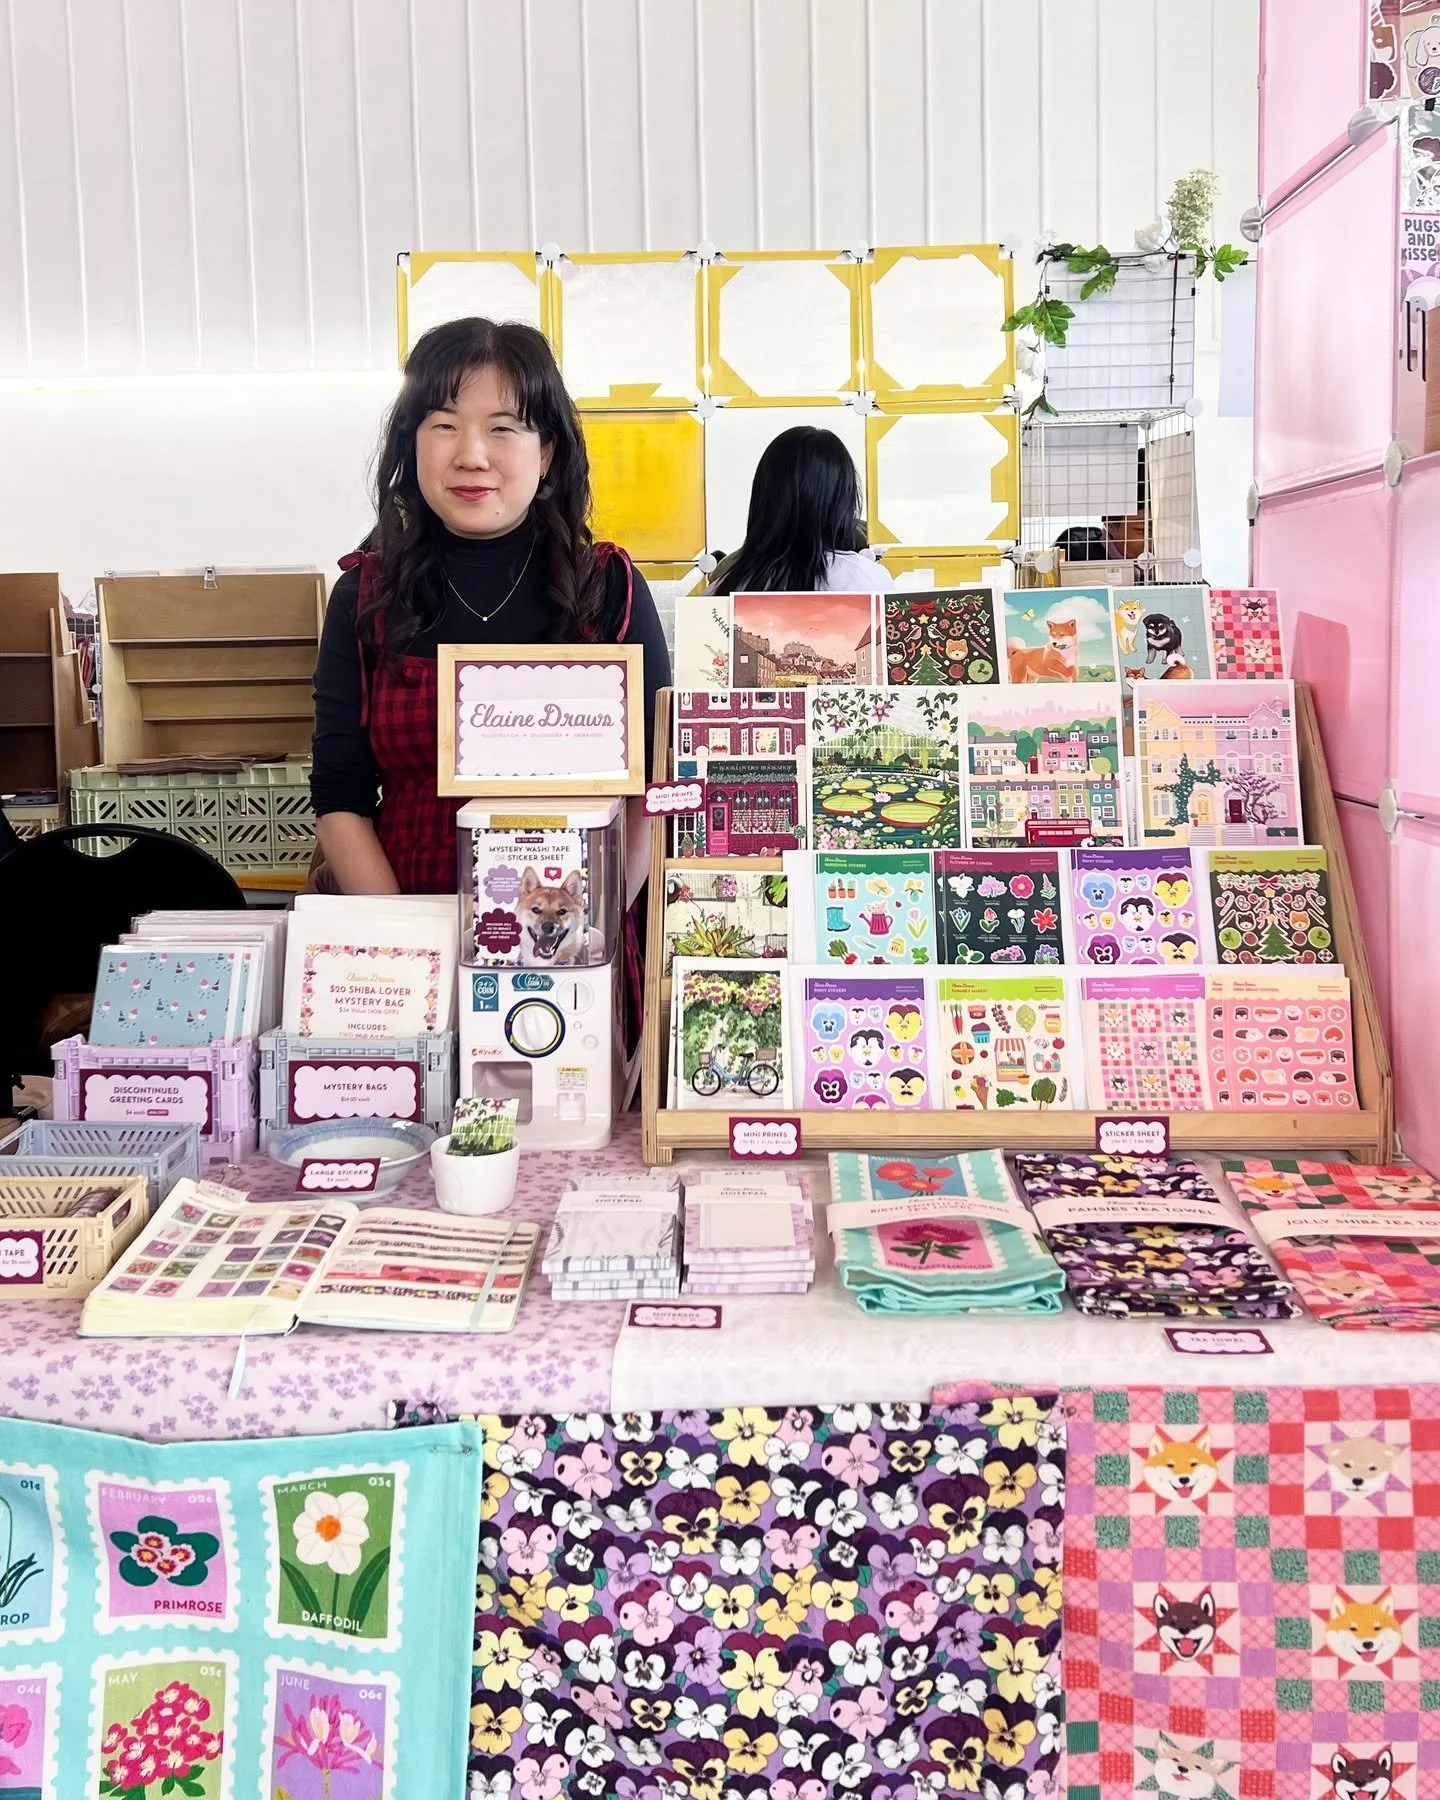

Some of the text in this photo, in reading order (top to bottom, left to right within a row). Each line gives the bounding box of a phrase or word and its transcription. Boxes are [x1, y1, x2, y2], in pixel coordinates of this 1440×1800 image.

[470, 703, 614, 728] Elaine Draws
[330, 985, 346, 993] $20
[478, 986, 494, 994] COIN
[335, 997, 404, 1007] MYSTERY BAG
[1164, 1207, 1216, 1215] TOWEL
[20, 1479, 41, 1491] 01¢
[278, 1481, 328, 1494] MARCH
[368, 1477, 392, 1488] 03¢
[101, 1487, 166, 1504] FEBRUARY
[154, 1600, 223, 1613] PRIMROSE
[302, 1610, 363, 1632] DAFFODIL
[108, 1672, 139, 1686] MAY
[280, 1674, 310, 1690] JUNE
[360, 1689, 382, 1700] 06¢
